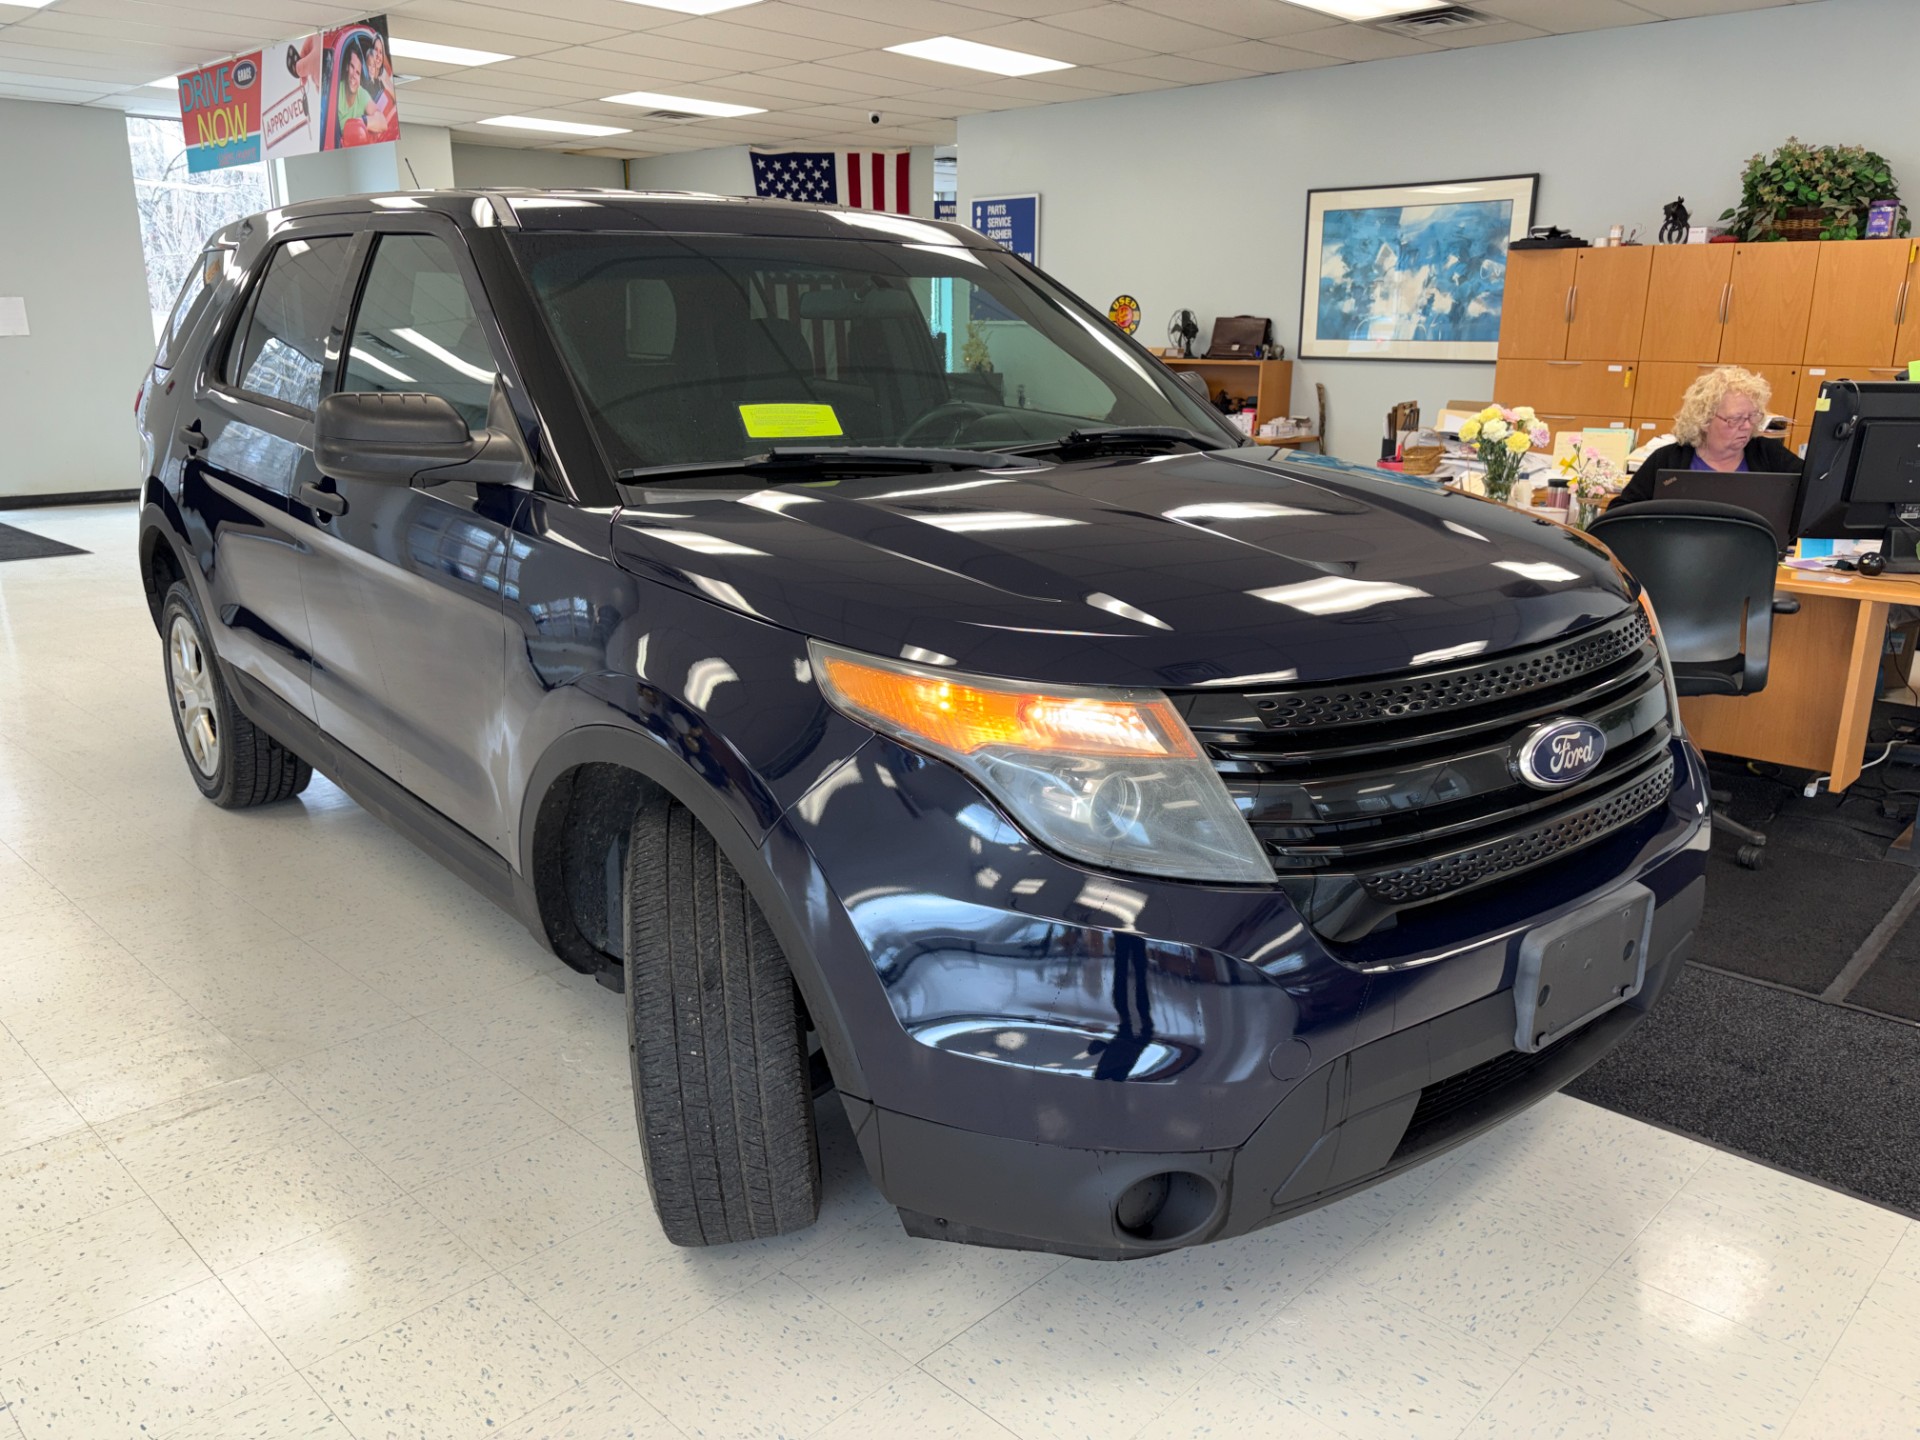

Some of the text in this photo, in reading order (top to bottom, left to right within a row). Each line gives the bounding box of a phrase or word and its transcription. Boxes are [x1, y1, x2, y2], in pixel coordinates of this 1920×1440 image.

[180, 66, 232, 112] DRIVE
[197, 102, 247, 150] NOW
[266, 98, 304, 137] APPROVED
[987, 204, 1006, 215] PARTS
[987, 216, 1012, 228] SERVICE
[987, 228, 1012, 240] CASHIER
[1113, 297, 1136, 309] USED
[1550, 732, 1594, 773] Ford
